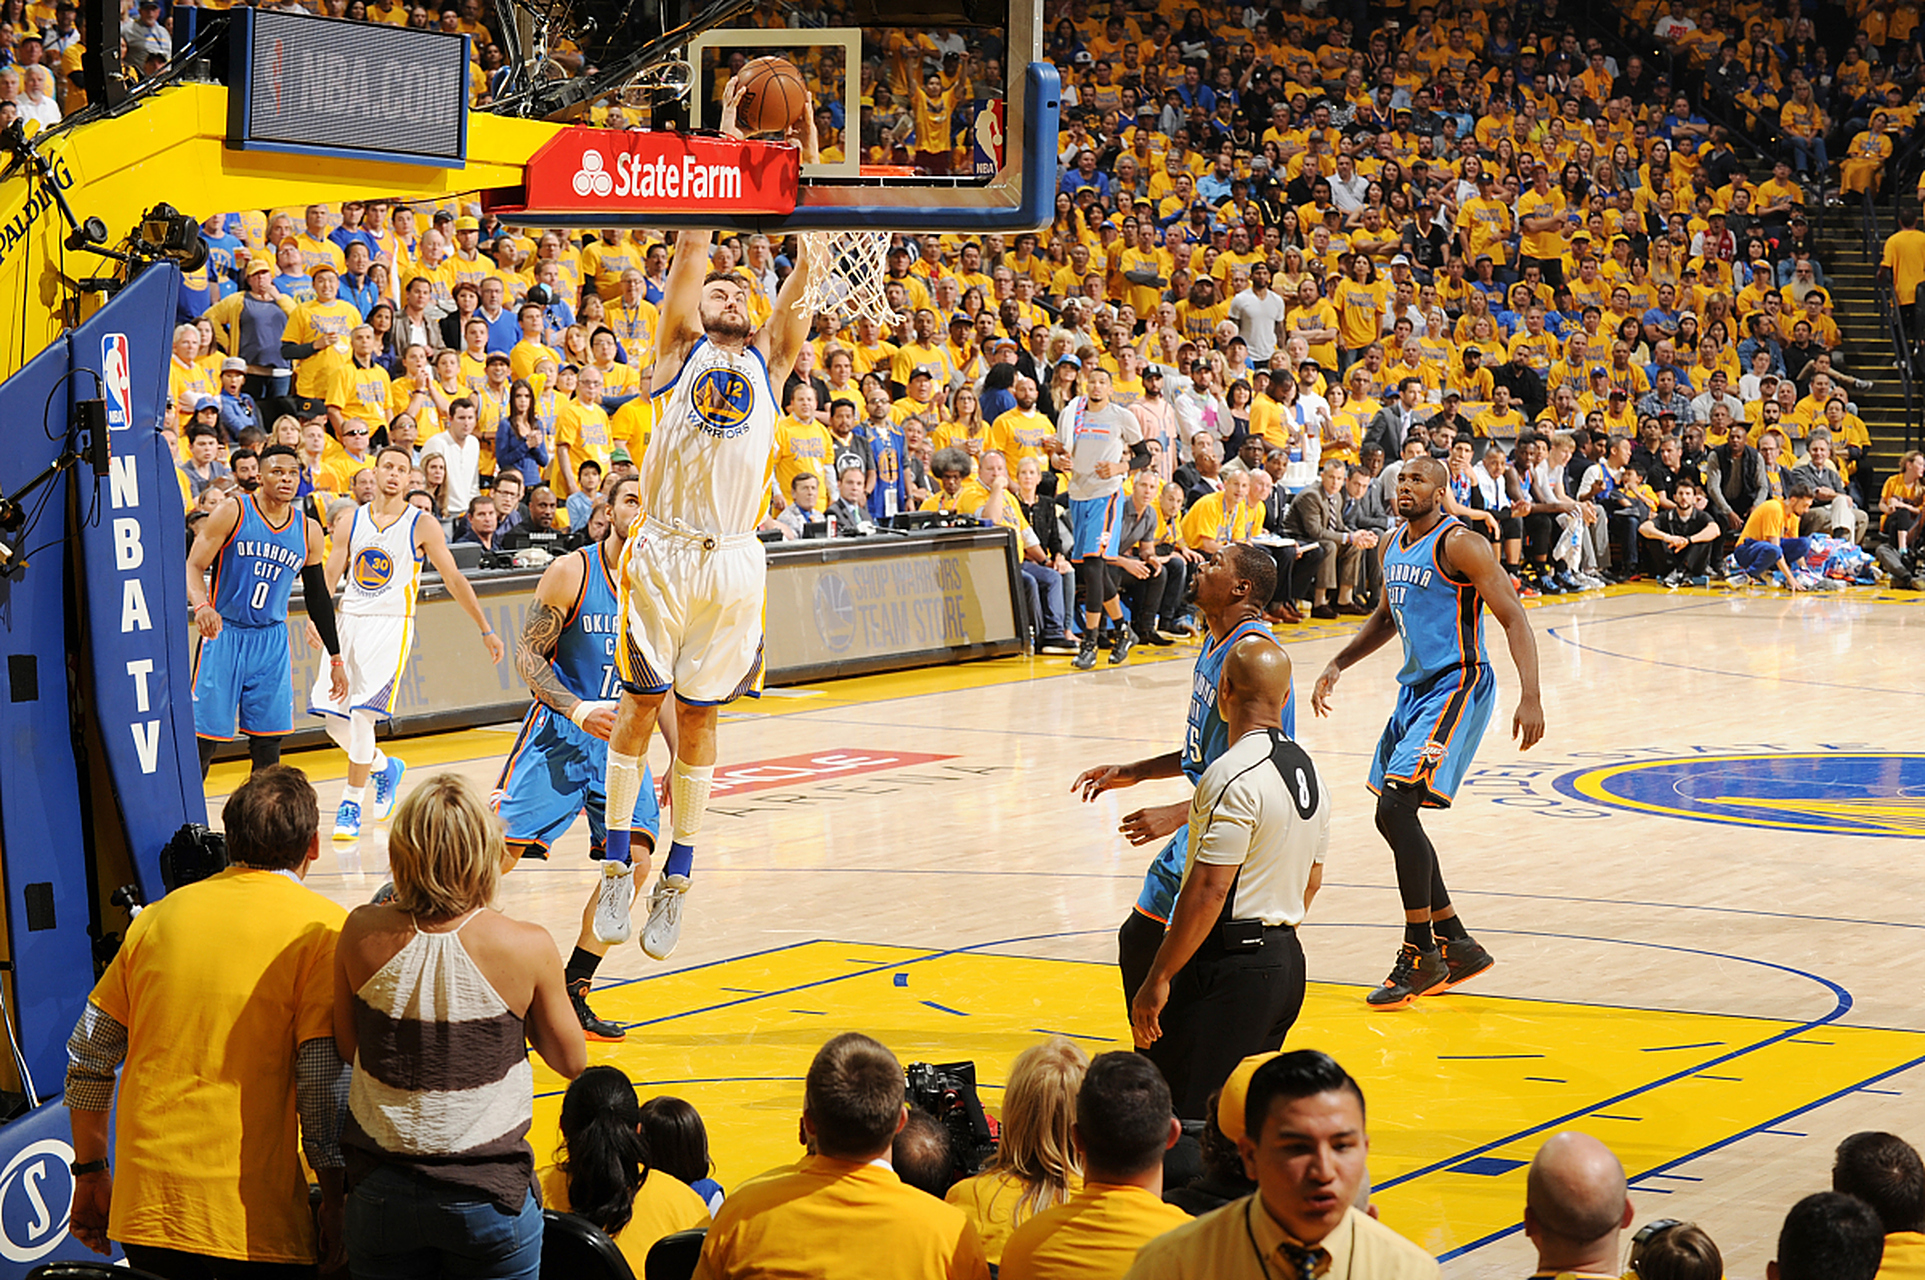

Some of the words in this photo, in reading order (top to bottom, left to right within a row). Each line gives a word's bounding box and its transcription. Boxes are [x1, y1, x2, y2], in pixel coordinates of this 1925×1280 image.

[977, 163, 994, 174] NBA
[0, 149, 75, 266] PALDING
[726, 380, 743, 399] 12
[687, 410, 750, 439] WARRIORS
[110, 455, 152, 632] NBA
[529, 532, 557, 540] SAMSUNG
[237, 541, 304, 571] OKLAHOMA
[372, 557, 389, 571] 30
[254, 561, 283, 582] CITY
[853, 564, 889, 600] SHOP
[890, 556, 962, 595] WARRIORS
[251, 581, 270, 609] 0
[858, 602, 912, 649] TEAM
[914, 594, 968, 643] STORE
[126, 659, 160, 774] TV
[705, 765, 1014, 818] ARENA
[1295, 767, 1311, 809] 8
